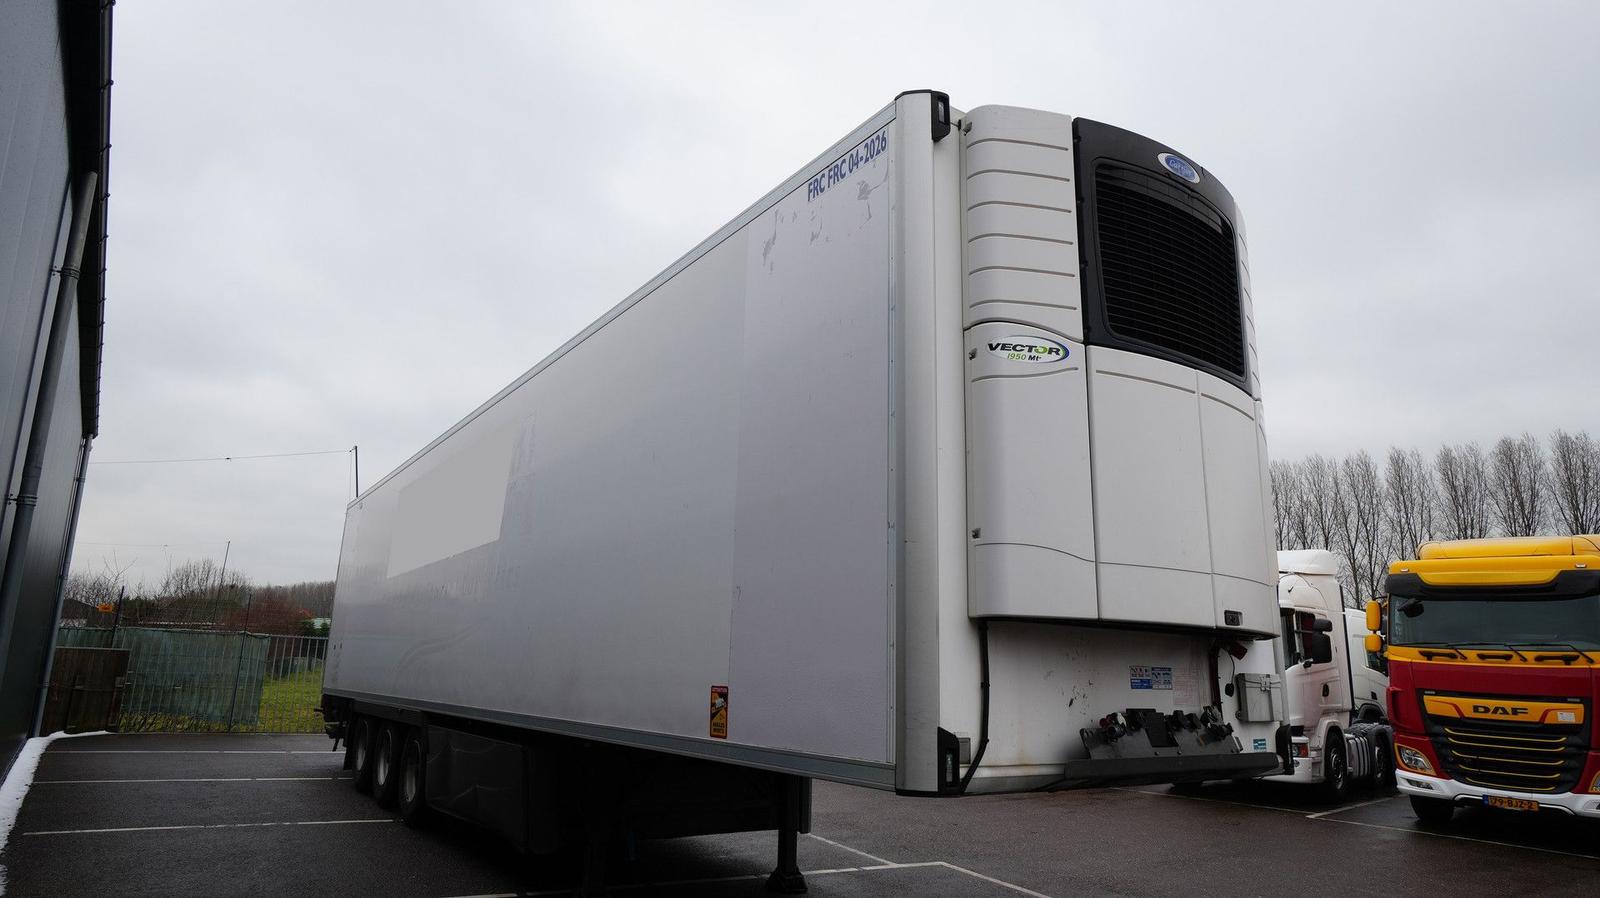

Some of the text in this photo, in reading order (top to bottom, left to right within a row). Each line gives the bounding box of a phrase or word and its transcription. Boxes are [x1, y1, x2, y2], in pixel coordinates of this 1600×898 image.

[808, 130, 887, 202] FRC FRC 04-2026
[988, 343, 1060, 356] VECTOR
[1007, 352, 1027, 360] 1950
[1473, 705, 1528, 716] DAF
